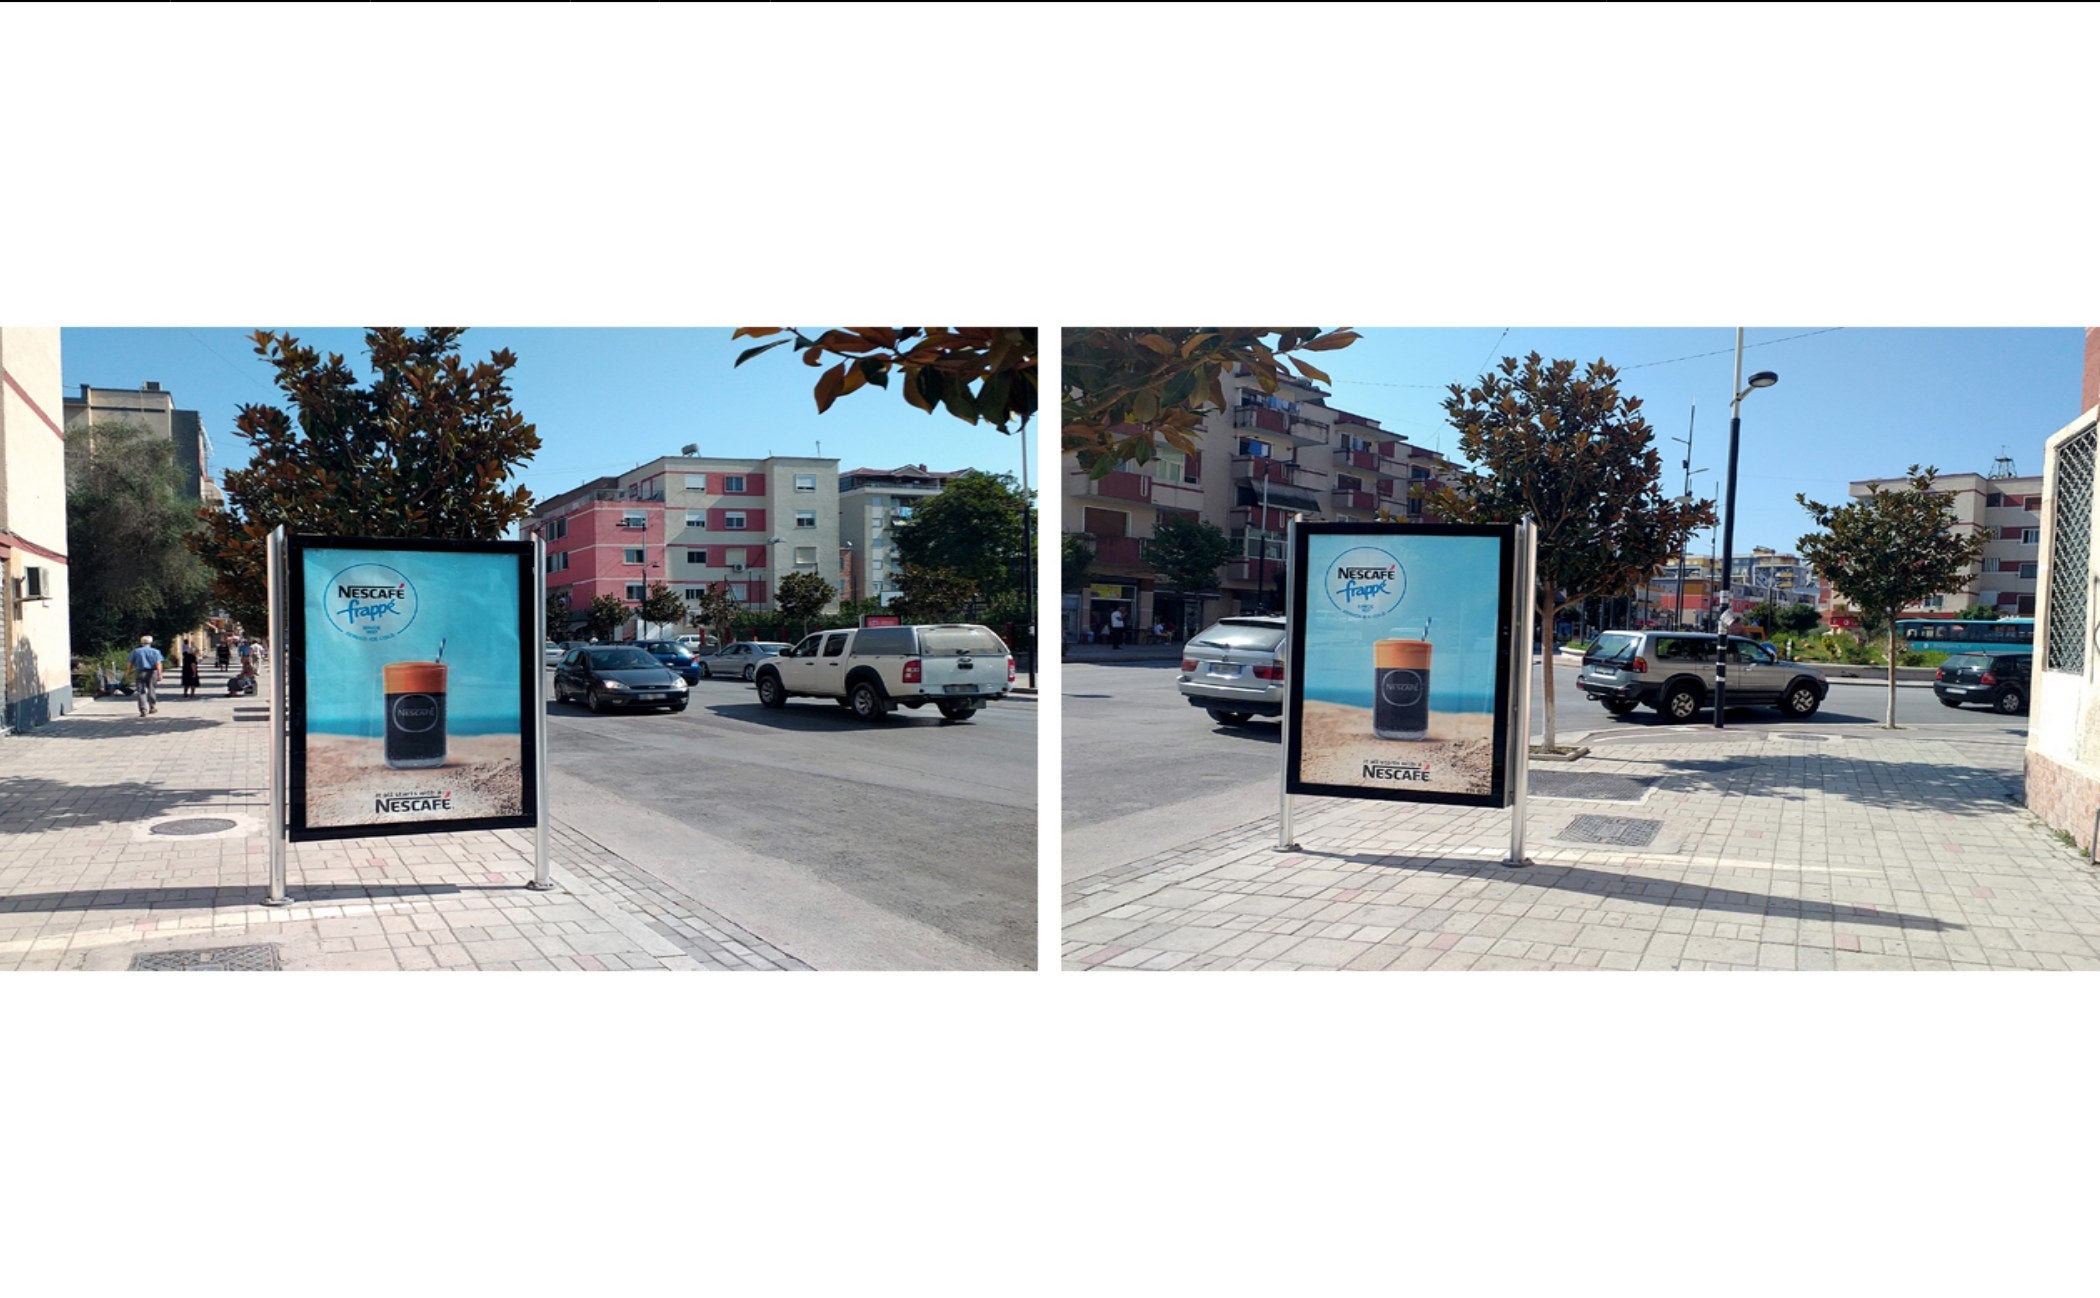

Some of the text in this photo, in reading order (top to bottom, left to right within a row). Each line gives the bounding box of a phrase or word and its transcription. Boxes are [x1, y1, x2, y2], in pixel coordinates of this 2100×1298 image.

[1337, 564, 1396, 580] NESCAFÉ
[338, 583, 405, 599] NESCAFÉ
[1336, 579, 1391, 603] frappé
[337, 599, 401, 624] frappé
[1362, 763, 1431, 782] NESCAFÉ
[375, 790, 451, 813] NESCAFÉ
